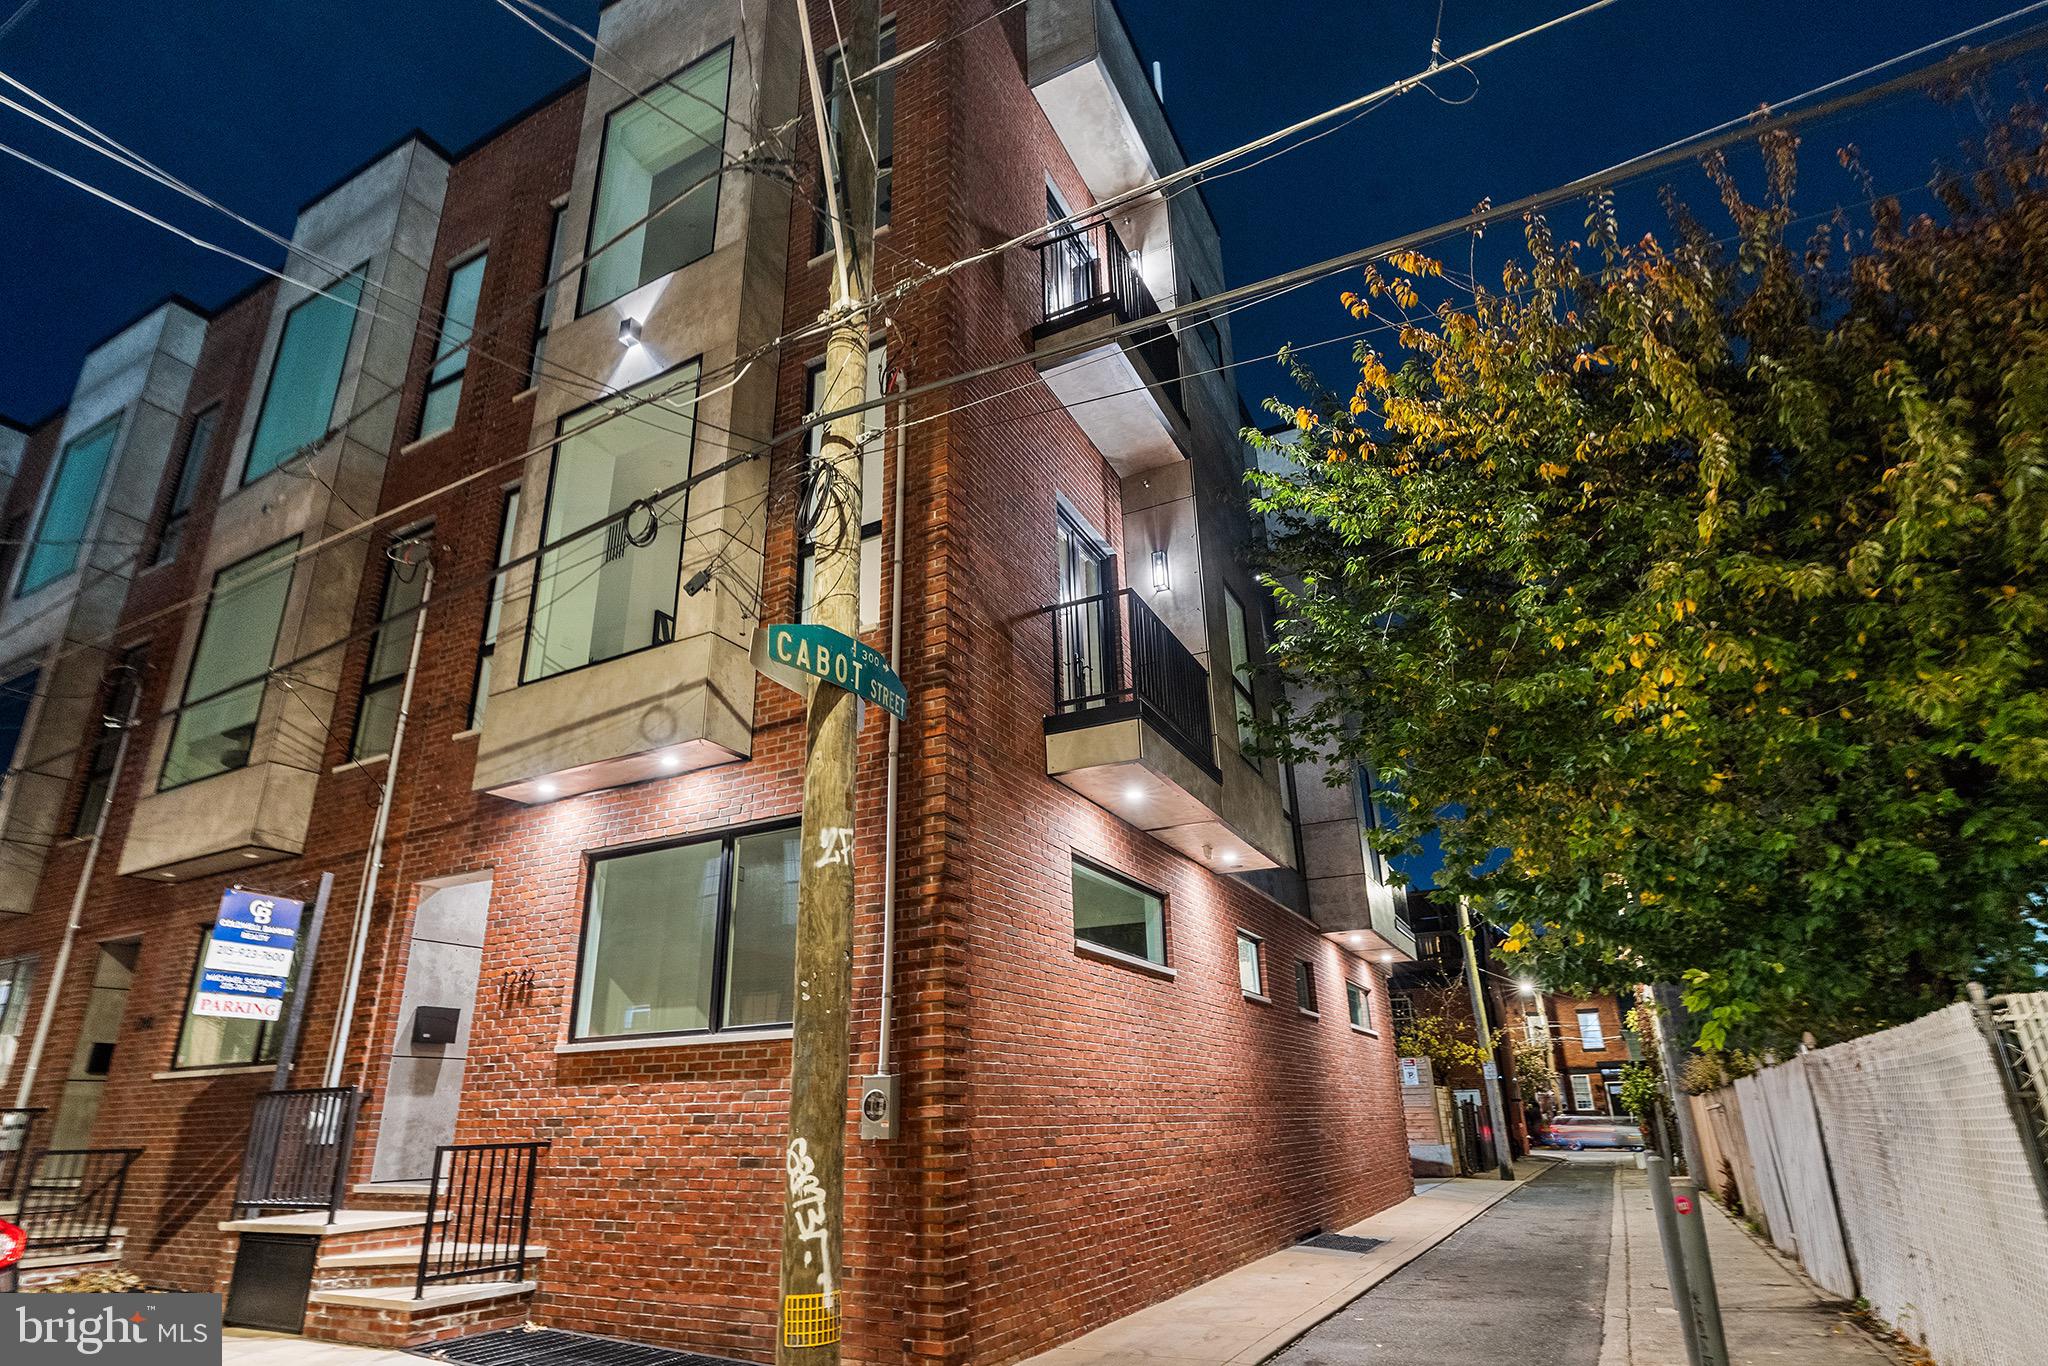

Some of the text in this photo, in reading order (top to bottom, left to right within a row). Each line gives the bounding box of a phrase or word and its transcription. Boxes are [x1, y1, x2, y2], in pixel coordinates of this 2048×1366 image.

[776, 630, 906, 718] CABOT STREET
[200, 998, 276, 1016] PARKING
